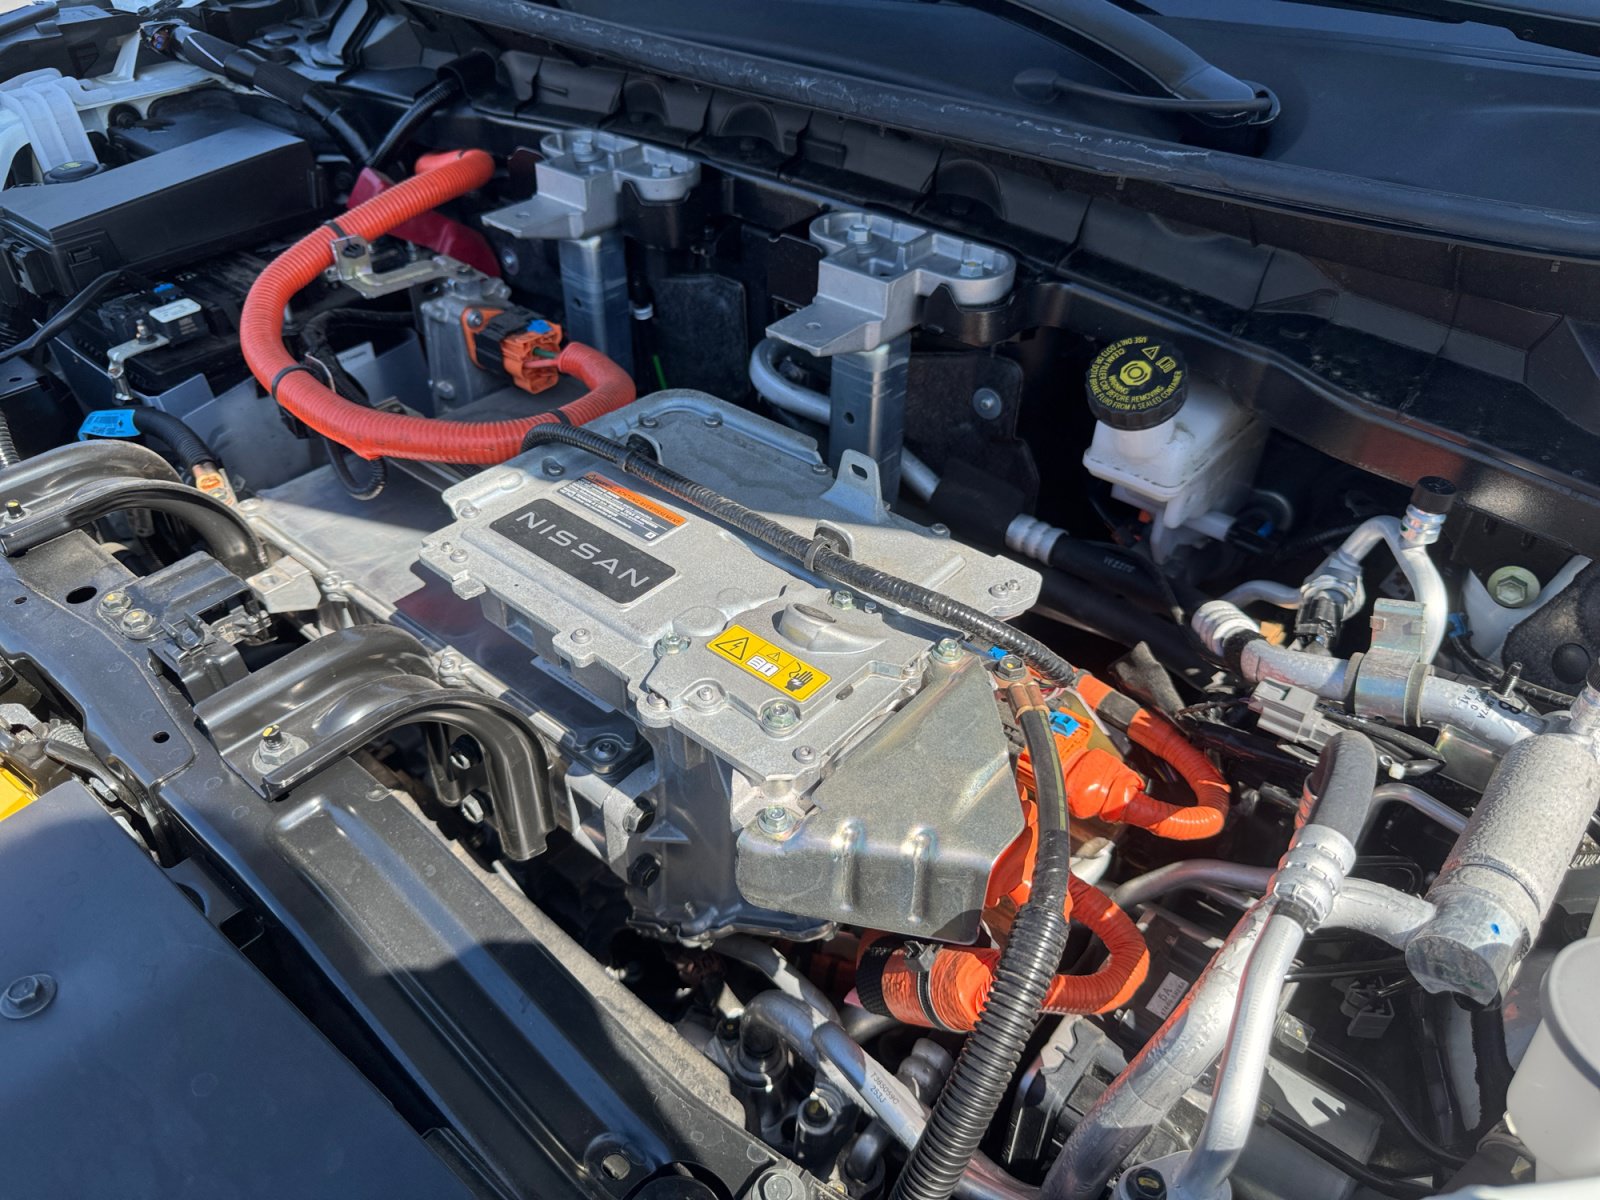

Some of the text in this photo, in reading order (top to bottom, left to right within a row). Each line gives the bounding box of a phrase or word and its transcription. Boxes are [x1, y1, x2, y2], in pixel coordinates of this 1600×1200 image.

[1116, 338, 1133, 348] ONLY
[1135, 336, 1148, 344] USE
[1106, 348, 1126, 364] CLEAN
[1089, 378, 1101, 396] BRAKE
[1160, 371, 1182, 399] CONTAINER
[1097, 393, 1113, 407] FLUID
[1107, 389, 1129, 402] BEFORE
[1131, 385, 1165, 402] REMOVING
[1112, 401, 1130, 410] FROM
[1137, 396, 1162, 410] SEALED
[515, 511, 650, 588] NISSAN
